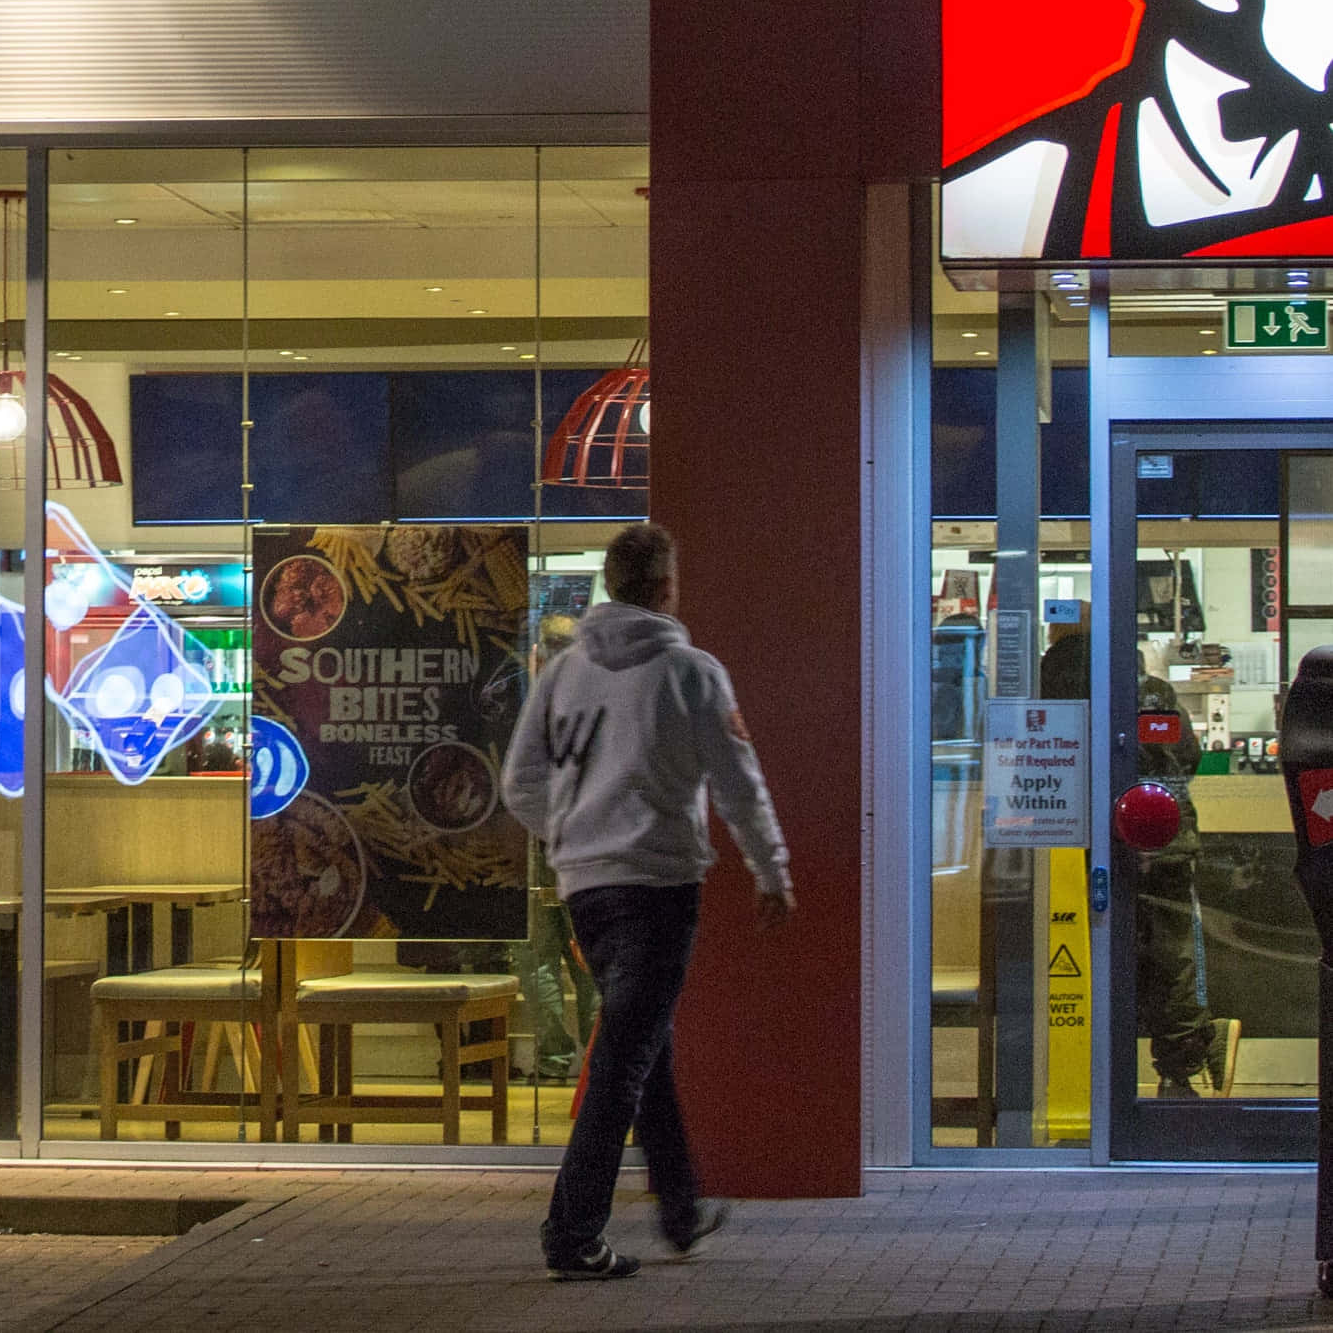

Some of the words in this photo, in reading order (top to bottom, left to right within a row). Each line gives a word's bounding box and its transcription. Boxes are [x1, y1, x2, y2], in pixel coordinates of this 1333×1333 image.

[278, 647, 480, 684] SOUTHERN
[330, 686, 440, 722] BITES
[319, 724, 458, 743] BONELESS
[1016, 740, 1027, 749] or
[1030, 738, 1051, 749] Part
[1053, 738, 1080, 749] Time
[369, 746, 412, 765] FEAST
[1026, 755, 1075, 770] Required
[1011, 774, 1063, 793] Apply
[1006, 795, 1067, 810] Within
[1049, 993, 1084, 1001] AUTION
[1050, 1003, 1077, 1014] WET
[1049, 1016, 1085, 1027] LOOR
